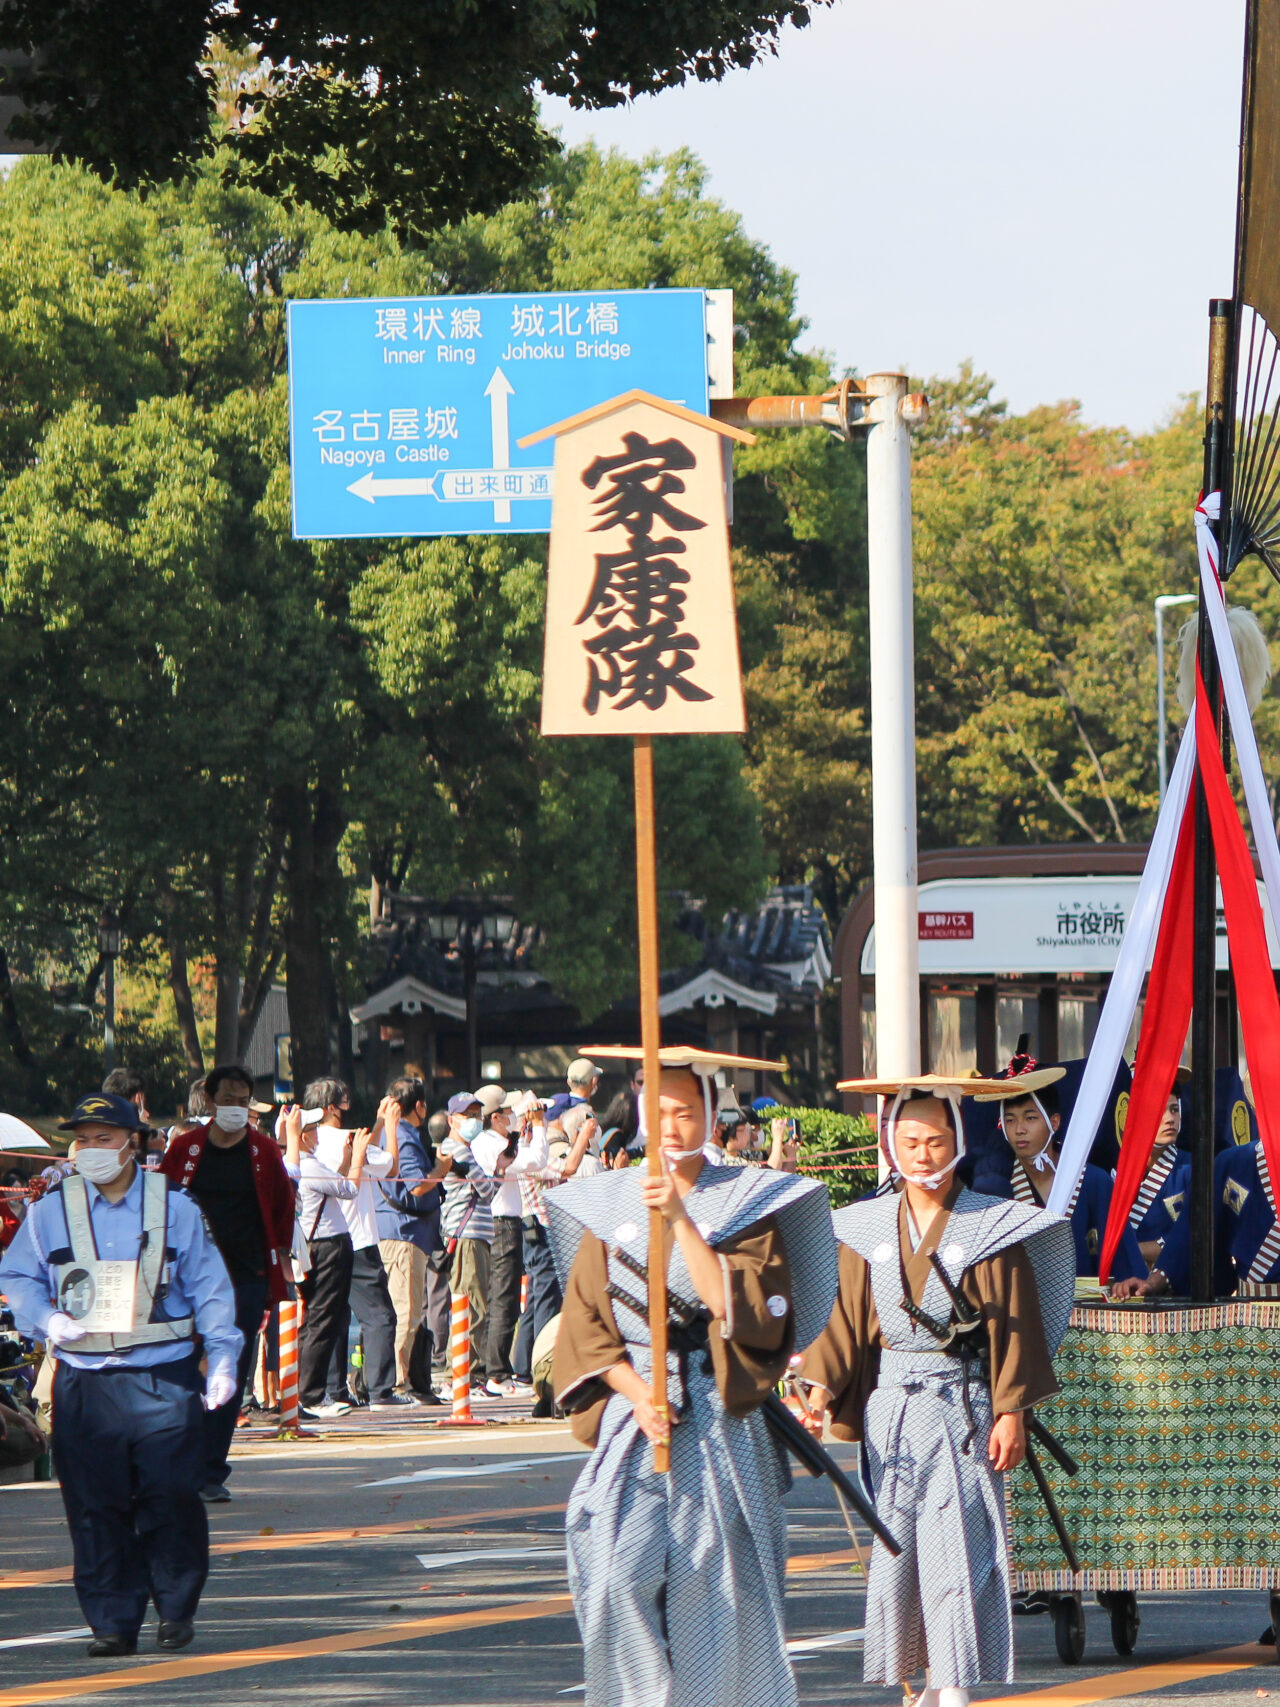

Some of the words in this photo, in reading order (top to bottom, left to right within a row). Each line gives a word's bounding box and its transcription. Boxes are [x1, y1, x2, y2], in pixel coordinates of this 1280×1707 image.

[375, 306, 483, 342] 環状線
[511, 302, 620, 338] 城北橋
[383, 347, 426, 364] Inner
[437, 346, 476, 365] Ring
[502, 343, 565, 360] Johoku
[575, 340, 631, 359] Bridge
[312, 405, 459, 444] 名古屋城
[320, 446, 386, 467] Nagoya
[396, 444, 449, 463] Castle
[454, 473, 550, 496] 出来町通
[572, 431, 715, 716] 家康隊
[1056, 912, 1125, 935] 市役所
[1036, 936, 1096, 948] Shiyakusho
